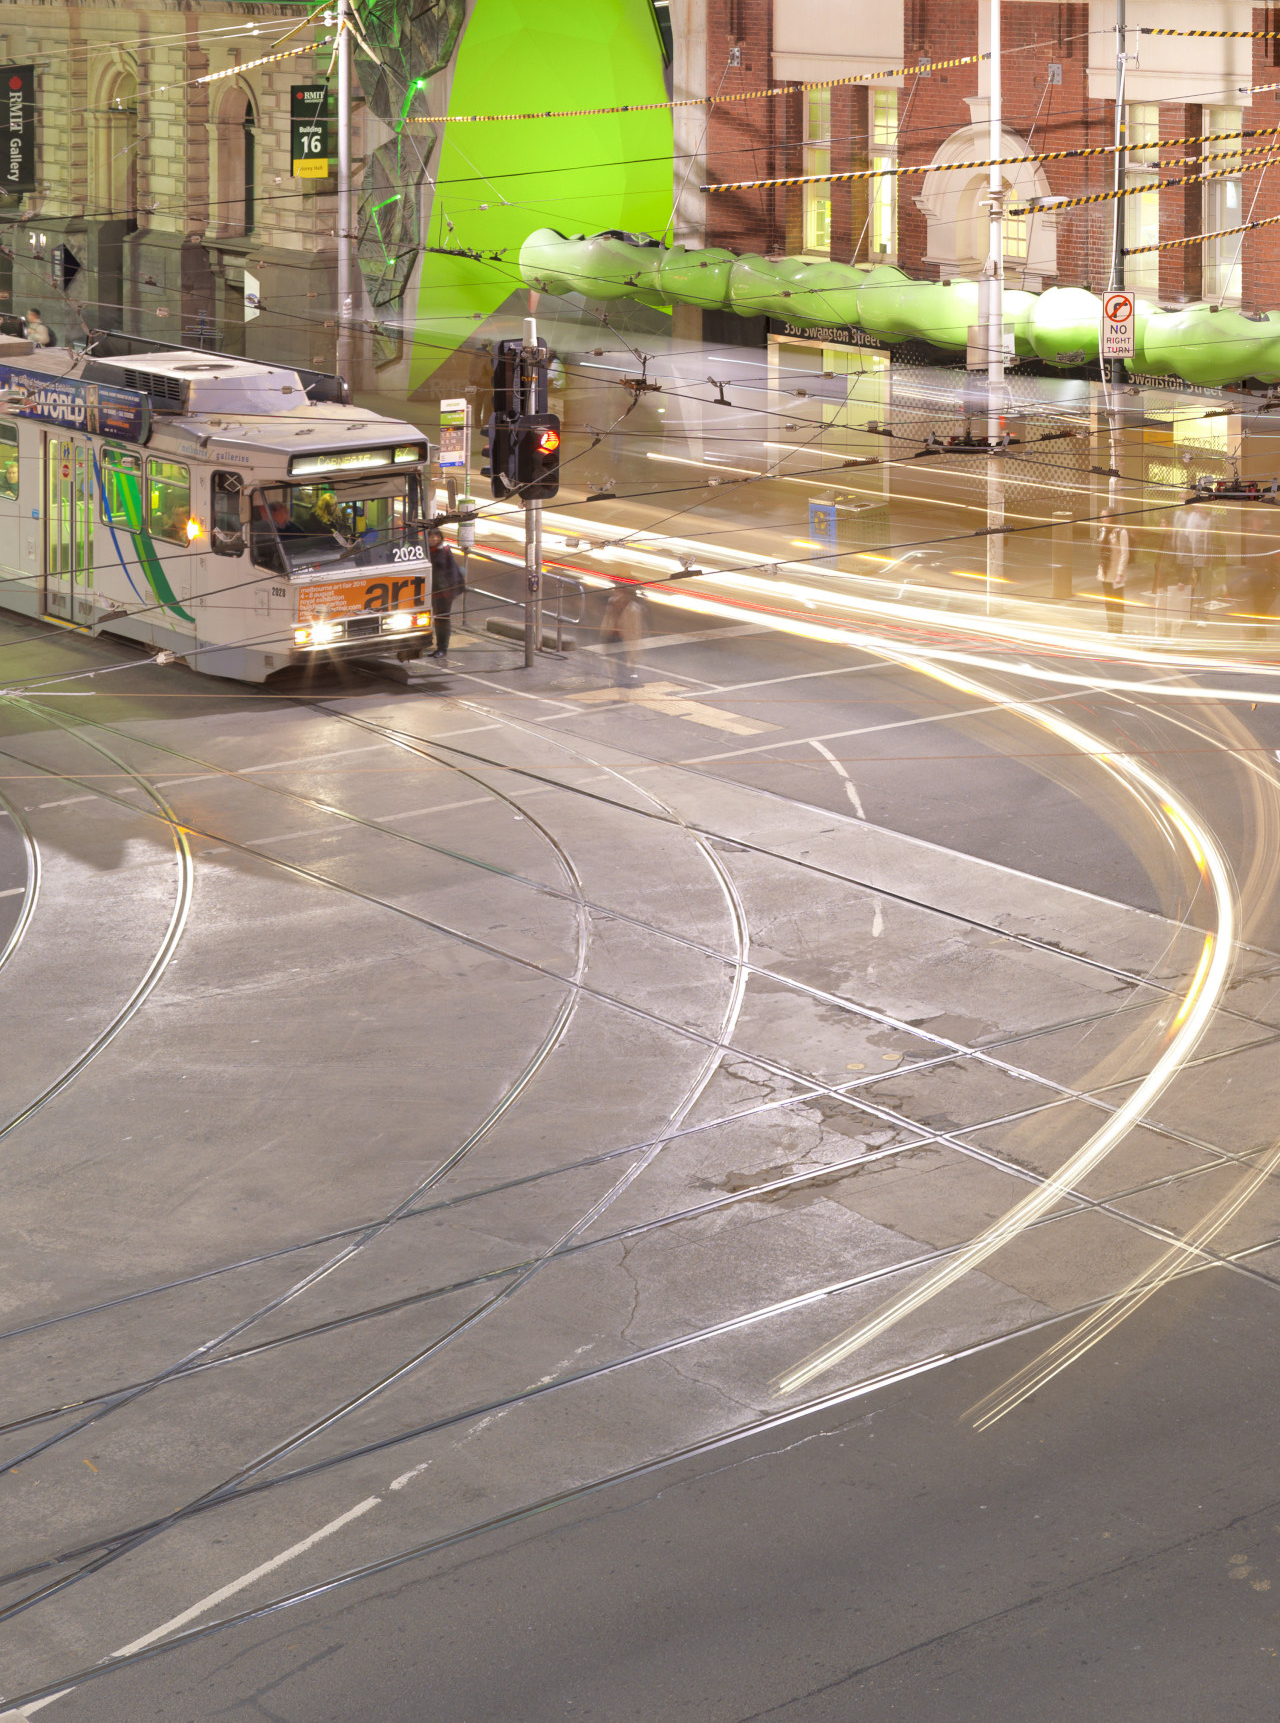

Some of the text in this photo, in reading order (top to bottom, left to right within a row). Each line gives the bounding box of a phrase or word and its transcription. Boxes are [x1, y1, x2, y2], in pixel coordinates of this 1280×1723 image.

[304, 91, 324, 99] RMIT
[7, 91, 23, 181] RMIT Gallery
[301, 135, 321, 153] 16
[804, 327, 849, 343] Swanston
[851, 328, 881, 346] Street
[1110, 325, 1128, 335] NO
[1107, 346, 1130, 354] TURN
[393, 545, 424, 562] 2028
[271, 587, 286, 597] 2028
[300, 585, 332, 594] melbourne
[352, 580, 366, 588] 2010
[316, 595, 345, 604] exhibition
[363, 576, 426, 615] art
